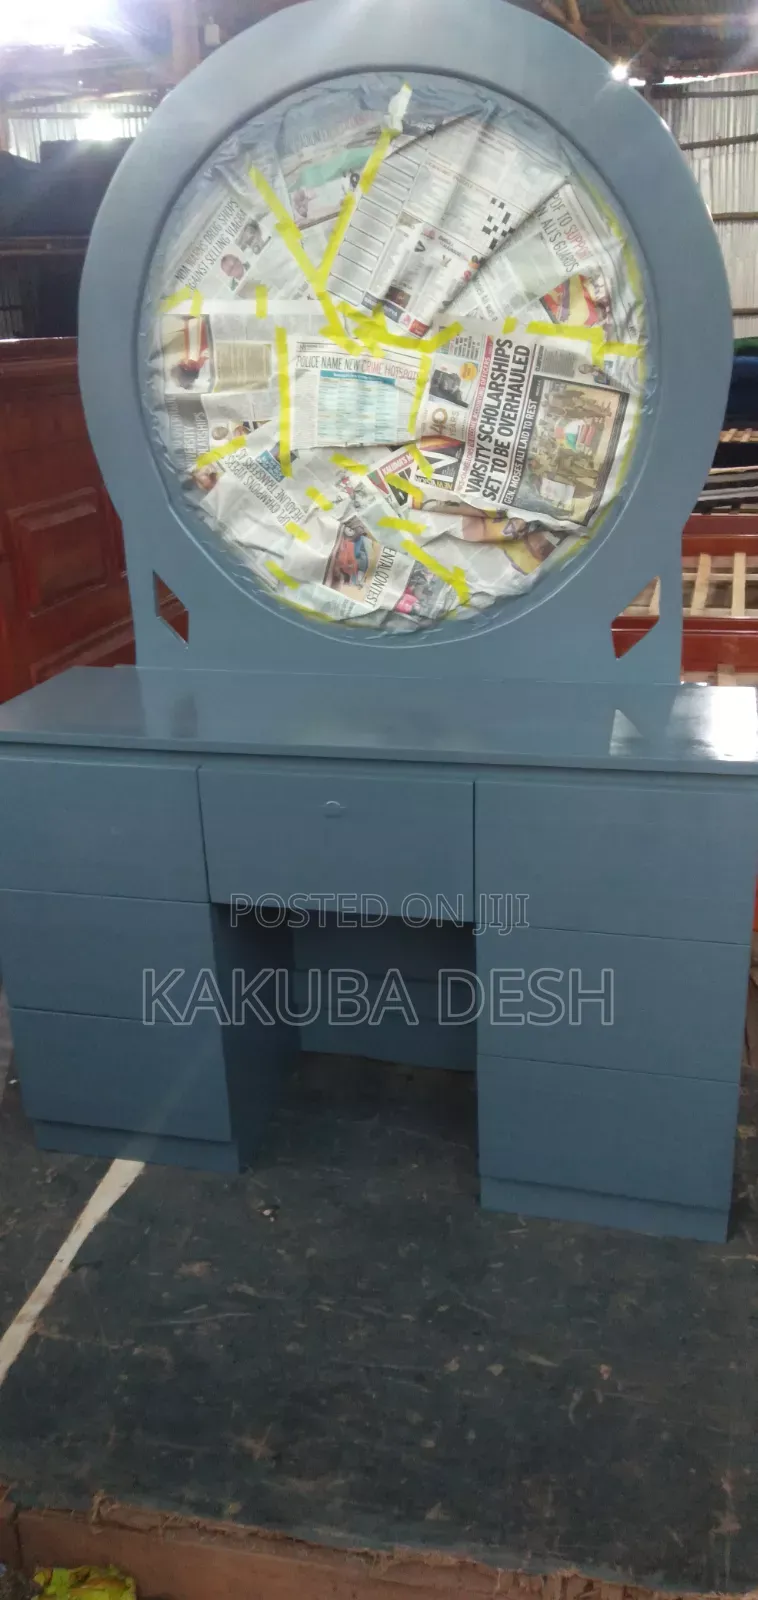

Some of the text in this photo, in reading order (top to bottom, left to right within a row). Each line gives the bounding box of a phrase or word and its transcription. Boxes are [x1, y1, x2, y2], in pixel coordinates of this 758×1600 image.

[541, 218, 562, 243] ALI'S
[557, 211, 572, 227] TO
[296, 355, 319, 368] POLICE
[321, 356, 342, 369] NAME
[344, 358, 359, 371] NEW
[361, 359, 384, 374] CRIME
[477, 339, 513, 443] SCHOLARSHIPS
[525, 399, 537, 420] REST
[482, 345, 530, 501] SET TO BE OVERHAULED
[523, 420, 533, 430] TO
[519, 431, 529, 449] LAID
[243, 457, 279, 494] TRANSFERS
[465, 442, 491, 492] VARSITY
[510, 462, 523, 488] MOSES
[243, 475, 280, 514] CHAMPIONS
[504, 490, 515, 504] GEN.
[365, 547, 397, 607] ENTAL CONTEST
